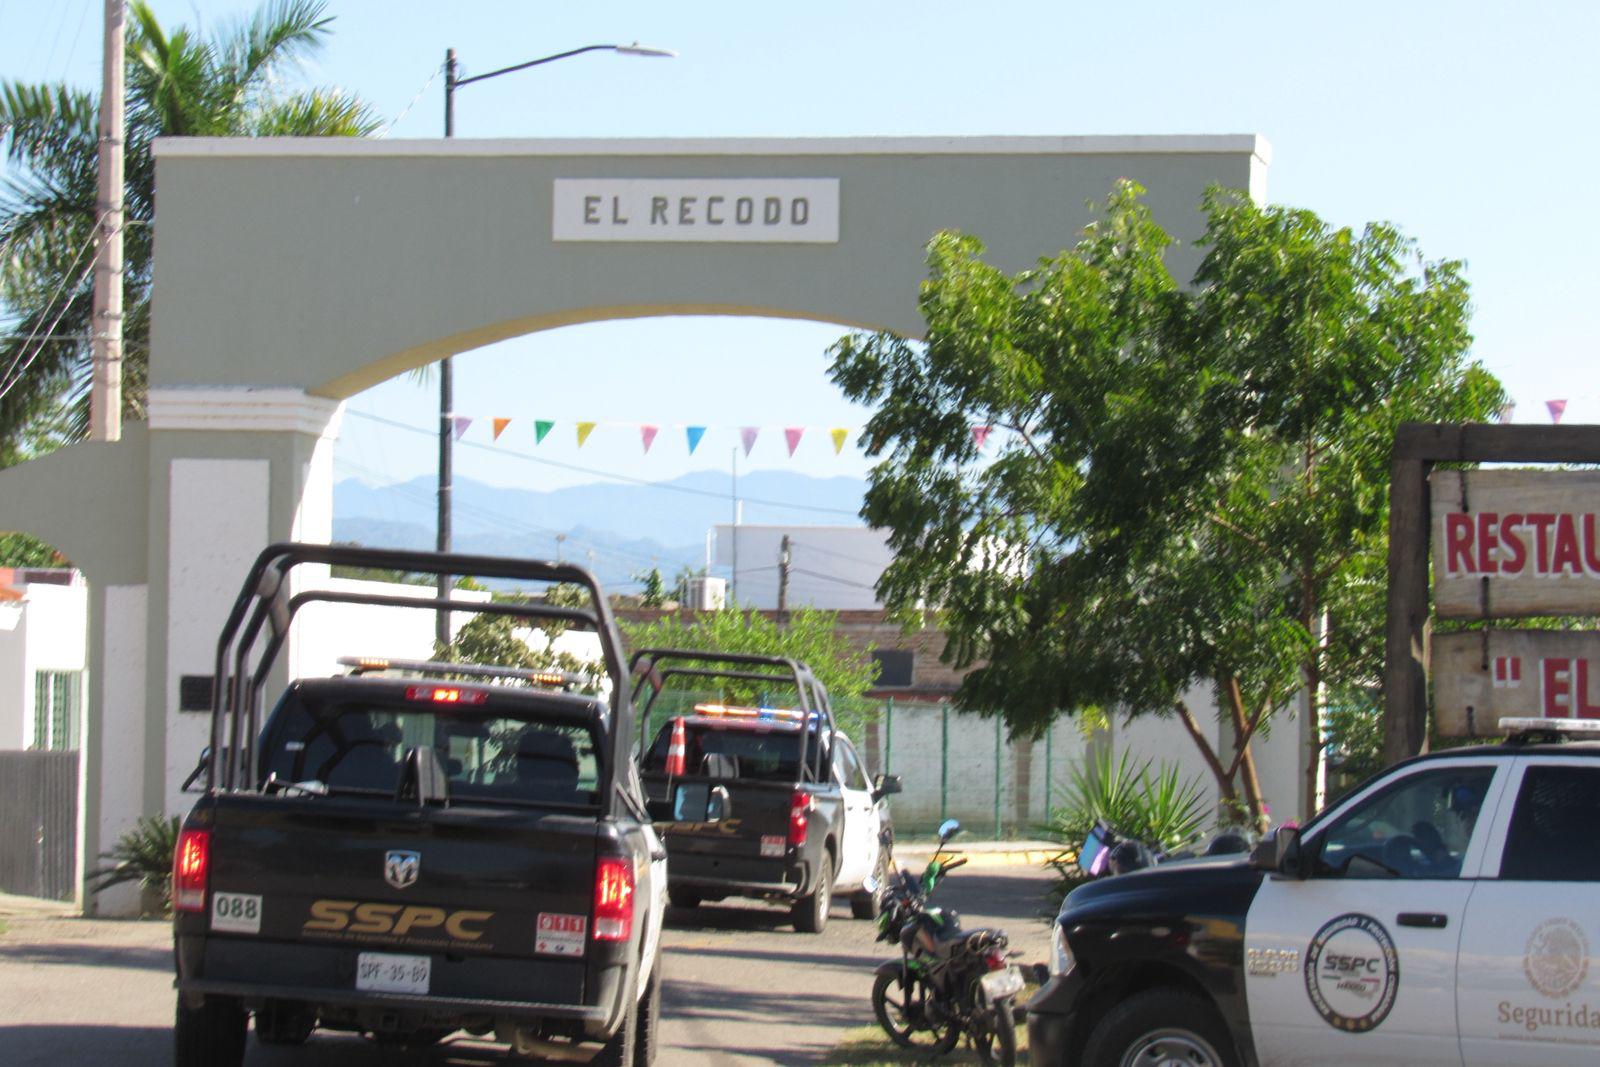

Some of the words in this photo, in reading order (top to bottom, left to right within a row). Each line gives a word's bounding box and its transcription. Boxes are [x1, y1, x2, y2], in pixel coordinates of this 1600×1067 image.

[583, 195, 629, 225] EL
[651, 196, 810, 226] RECODO
[216, 896, 257, 919] 088
[303, 899, 496, 941] SSPC
[1323, 954, 1381, 973] SSPC
